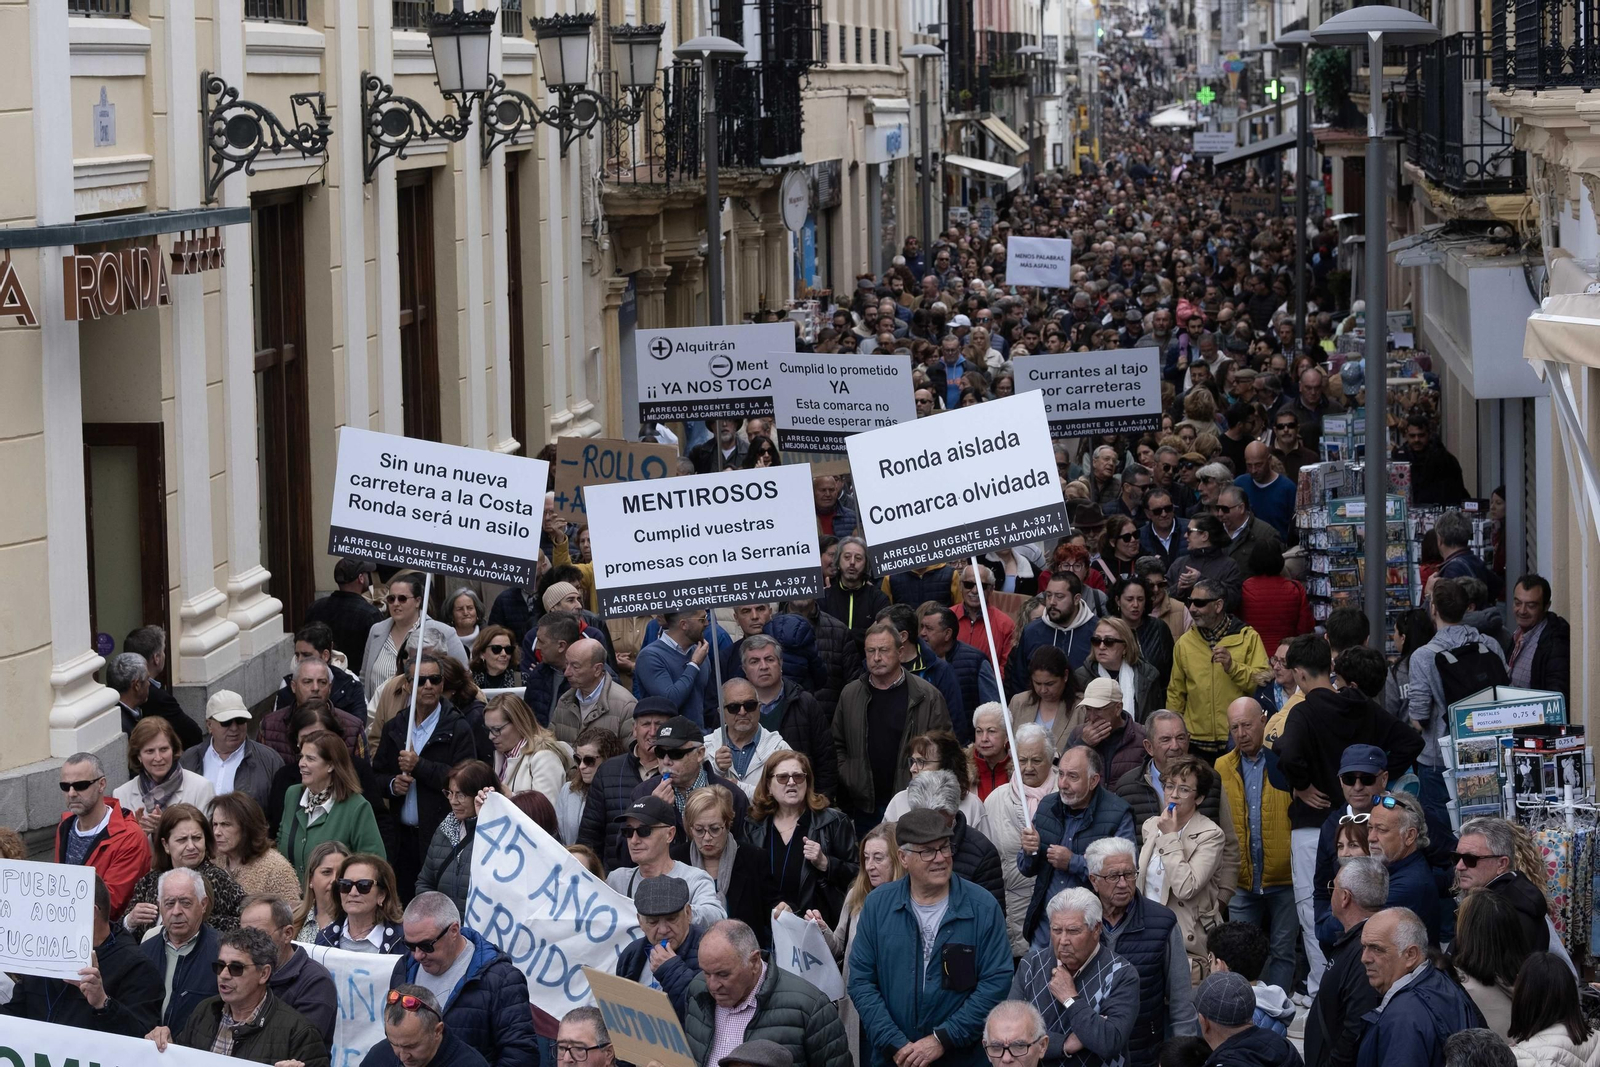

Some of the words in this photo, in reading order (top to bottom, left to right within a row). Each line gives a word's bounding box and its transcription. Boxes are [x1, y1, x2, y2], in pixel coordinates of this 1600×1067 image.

[75, 246, 173, 320] RONDA
[675, 340, 736, 354] Alquitrán
[780, 362, 824, 376] Cumplid
[827, 364, 838, 375] lo
[840, 365, 898, 377] prometido
[1028, 366, 1101, 381] Currantes
[1104, 364, 1117, 376] al
[1121, 362, 1148, 377] tajo
[661, 382, 682, 395] YA
[687, 379, 723, 394] NOS
[727, 377, 772, 392] TOCA
[829, 380, 850, 394] YA
[1065, 381, 1141, 396] carreteras
[676, 412, 685, 420] DE
[700, 410, 745, 418] CARRETERAS
[796, 398, 820, 410] Esta
[823, 401, 873, 412] comarca
[875, 403, 890, 412] no
[1056, 400, 1090, 413] mala
[1094, 396, 1146, 410] muerte
[791, 414, 825, 426] puede
[828, 416, 872, 428] esperar
[1066, 422, 1100, 430] URGENTE
[1130, 418, 1152, 426] A-397
[1072, 428, 1114, 436] CARRETERAS
[1120, 424, 1147, 432] AUTOVÍA
[786, 435, 820, 443] ARREGLO
[878, 449, 942, 479] Ronda
[946, 430, 1020, 463] aislada
[380, 452, 408, 472] Sin
[414, 462, 447, 478] una
[453, 468, 508, 488] nueva
[350, 474, 436, 500] carretera
[441, 490, 452, 502] a
[458, 488, 473, 506] la
[480, 493, 533, 516] Costa
[622, 480, 778, 514] MENTIROSOS
[869, 491, 958, 525] Comarca
[962, 468, 1050, 503] olvidada
[348, 493, 406, 518] Ronda
[412, 508, 452, 526] será
[458, 516, 480, 530] un
[486, 520, 530, 538] asilo
[633, 523, 700, 543] Cumplid
[704, 518, 775, 536] vuestras
[883, 542, 928, 560] ARREGLO
[933, 530, 980, 548] URGENTE
[986, 526, 1000, 536] DE
[1004, 522, 1018, 532] LA
[1023, 514, 1052, 528] A-397
[915, 554, 927, 563] DE
[928, 550, 944, 561] LAS
[944, 538, 1000, 557] CARRETERAS
[1000, 536, 1006, 544] Y
[1008, 527, 1046, 543] AUTOVÍA
[1046, 524, 1059, 534] YA
[342, 536, 392, 551] ARREGLO
[398, 545, 448, 560] URGENTE
[453, 555, 467, 564] DE
[472, 558, 486, 568] LA
[491, 562, 522, 574] A-397
[374, 551, 386, 560] DE
[388, 554, 404, 564] LAS
[406, 556, 464, 574] CARRETERAS
[472, 568, 512, 582] AUTOVÍA
[513, 576, 524, 584] YA
[604, 554, 684, 578] promesas
[688, 552, 718, 566] con
[722, 548, 737, 562] la
[741, 541, 811, 560] Serranía
[613, 590, 666, 604] ARREGLO
[672, 584, 727, 597] URGENTE
[733, 582, 748, 591] DE
[754, 580, 768, 589] LA
[774, 576, 806, 586] A-397
[650, 602, 663, 610] DE
[664, 600, 683, 609] LAS
[685, 593, 748, 606] CARRETERAS
[749, 592, 756, 600] Y
[757, 586, 799, 599] AUTOVÍA
[800, 586, 813, 595] YA
[1512, 712, 1529, 720] 0,75
[1558, 738, 1570, 746] 0,75
[476, 815, 537, 883] 45
[3, 869, 88, 900] PUEBLO
[0, 927, 90, 960] UCHALO
[464, 878, 591, 1002] ERDIDO
